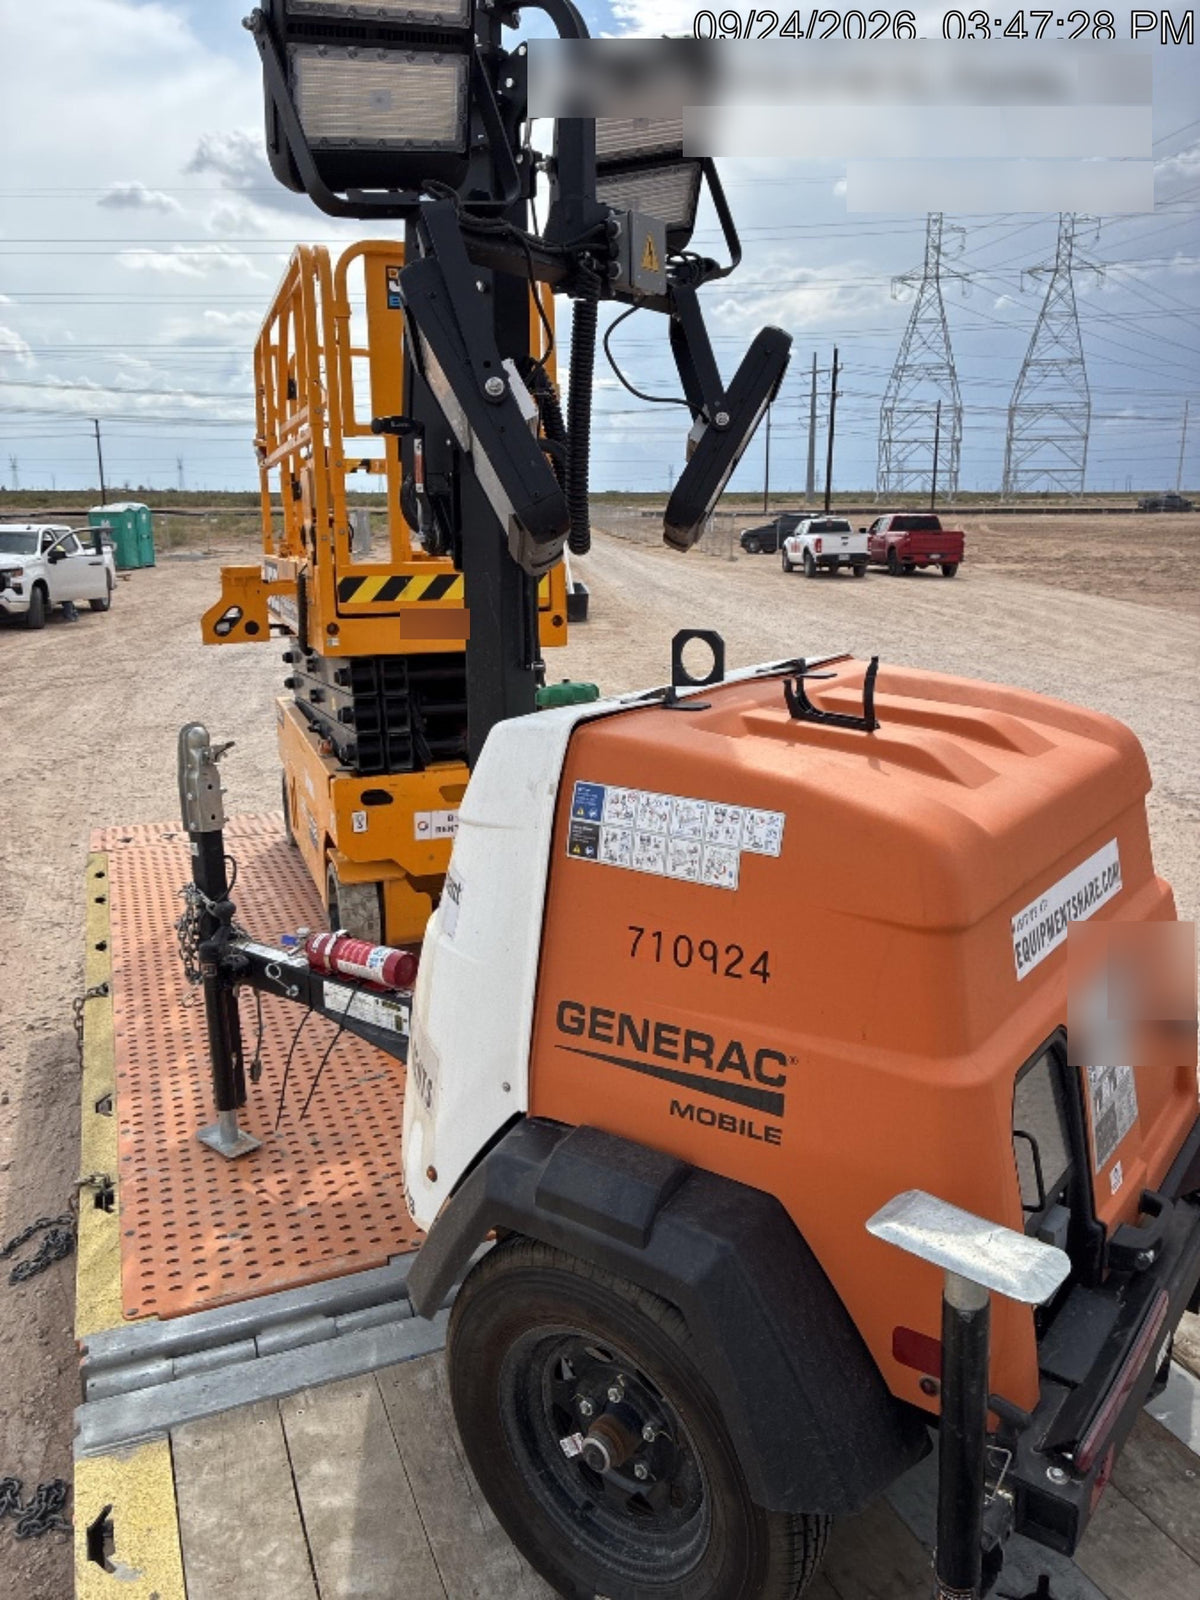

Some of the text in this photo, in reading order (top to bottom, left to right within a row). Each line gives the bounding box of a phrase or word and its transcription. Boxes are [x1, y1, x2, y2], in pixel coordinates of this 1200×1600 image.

[1015, 861, 1120, 969] EQUIPMENTSHARE.COM
[628, 926, 771, 984] 710924
[669, 1099, 784, 1146] MOBILE
